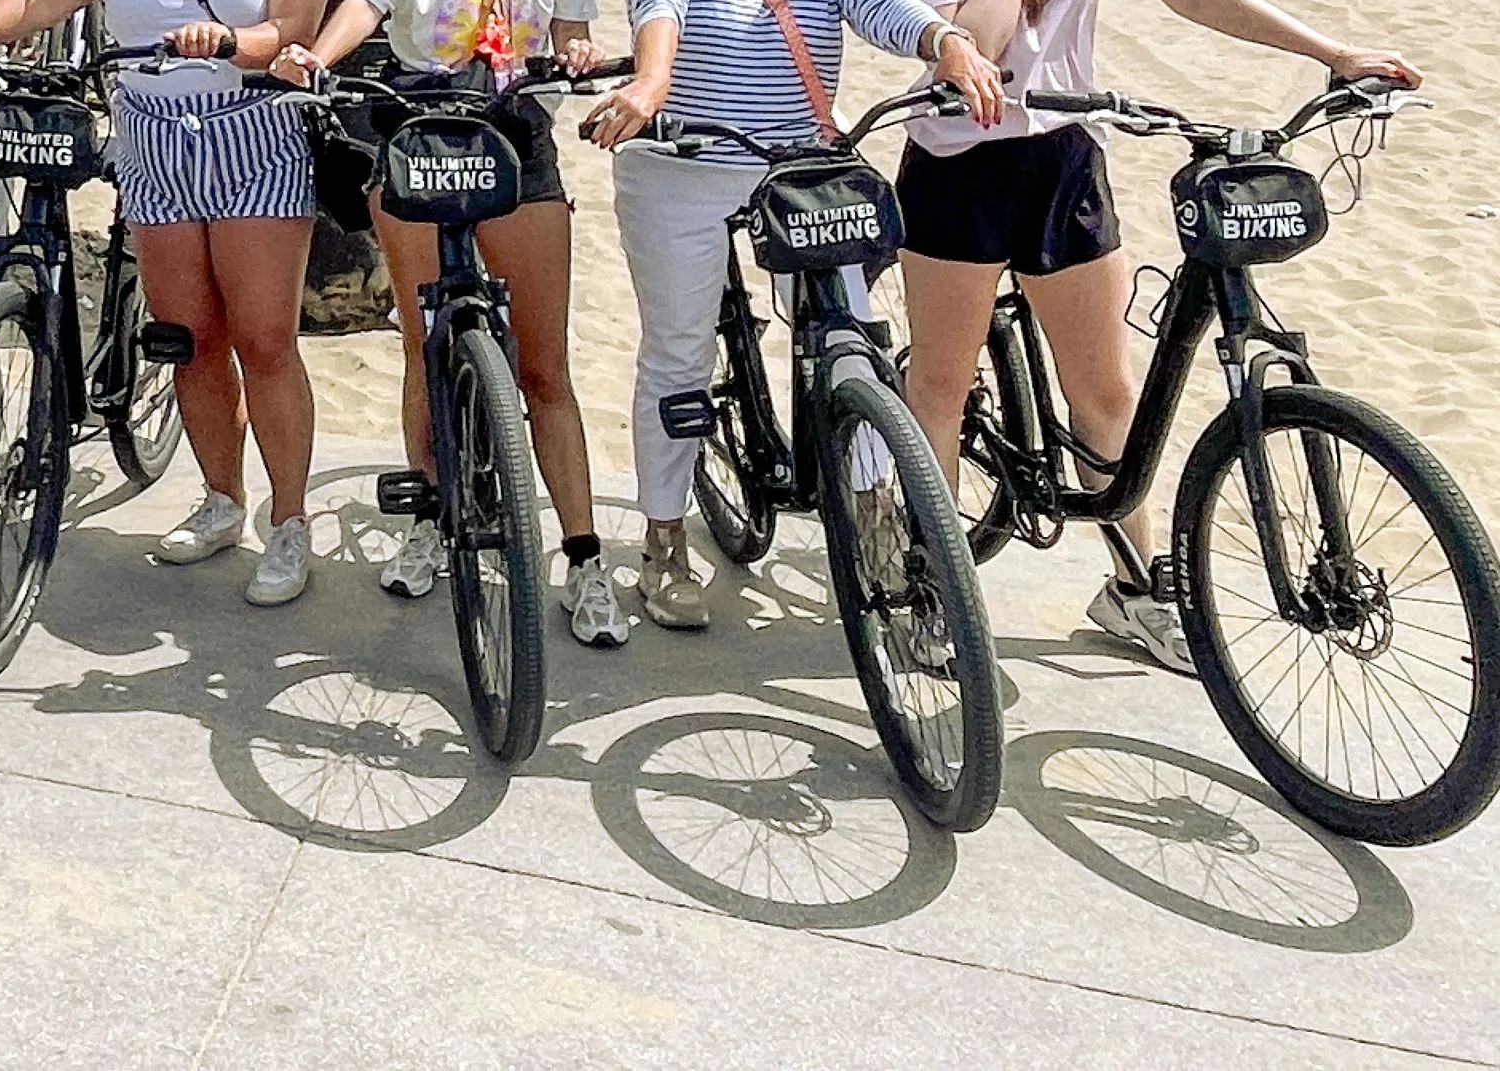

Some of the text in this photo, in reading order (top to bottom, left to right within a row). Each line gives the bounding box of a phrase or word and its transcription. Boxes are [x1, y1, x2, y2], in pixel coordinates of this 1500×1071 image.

[407, 156, 496, 171] UNLIMITED
[409, 170, 497, 190] BIKING
[787, 202, 877, 227] UNLIMITED
[1223, 201, 1302, 218] UNLIMITED
[789, 218, 882, 248] BIKING
[1223, 216, 1308, 240] BIKING
